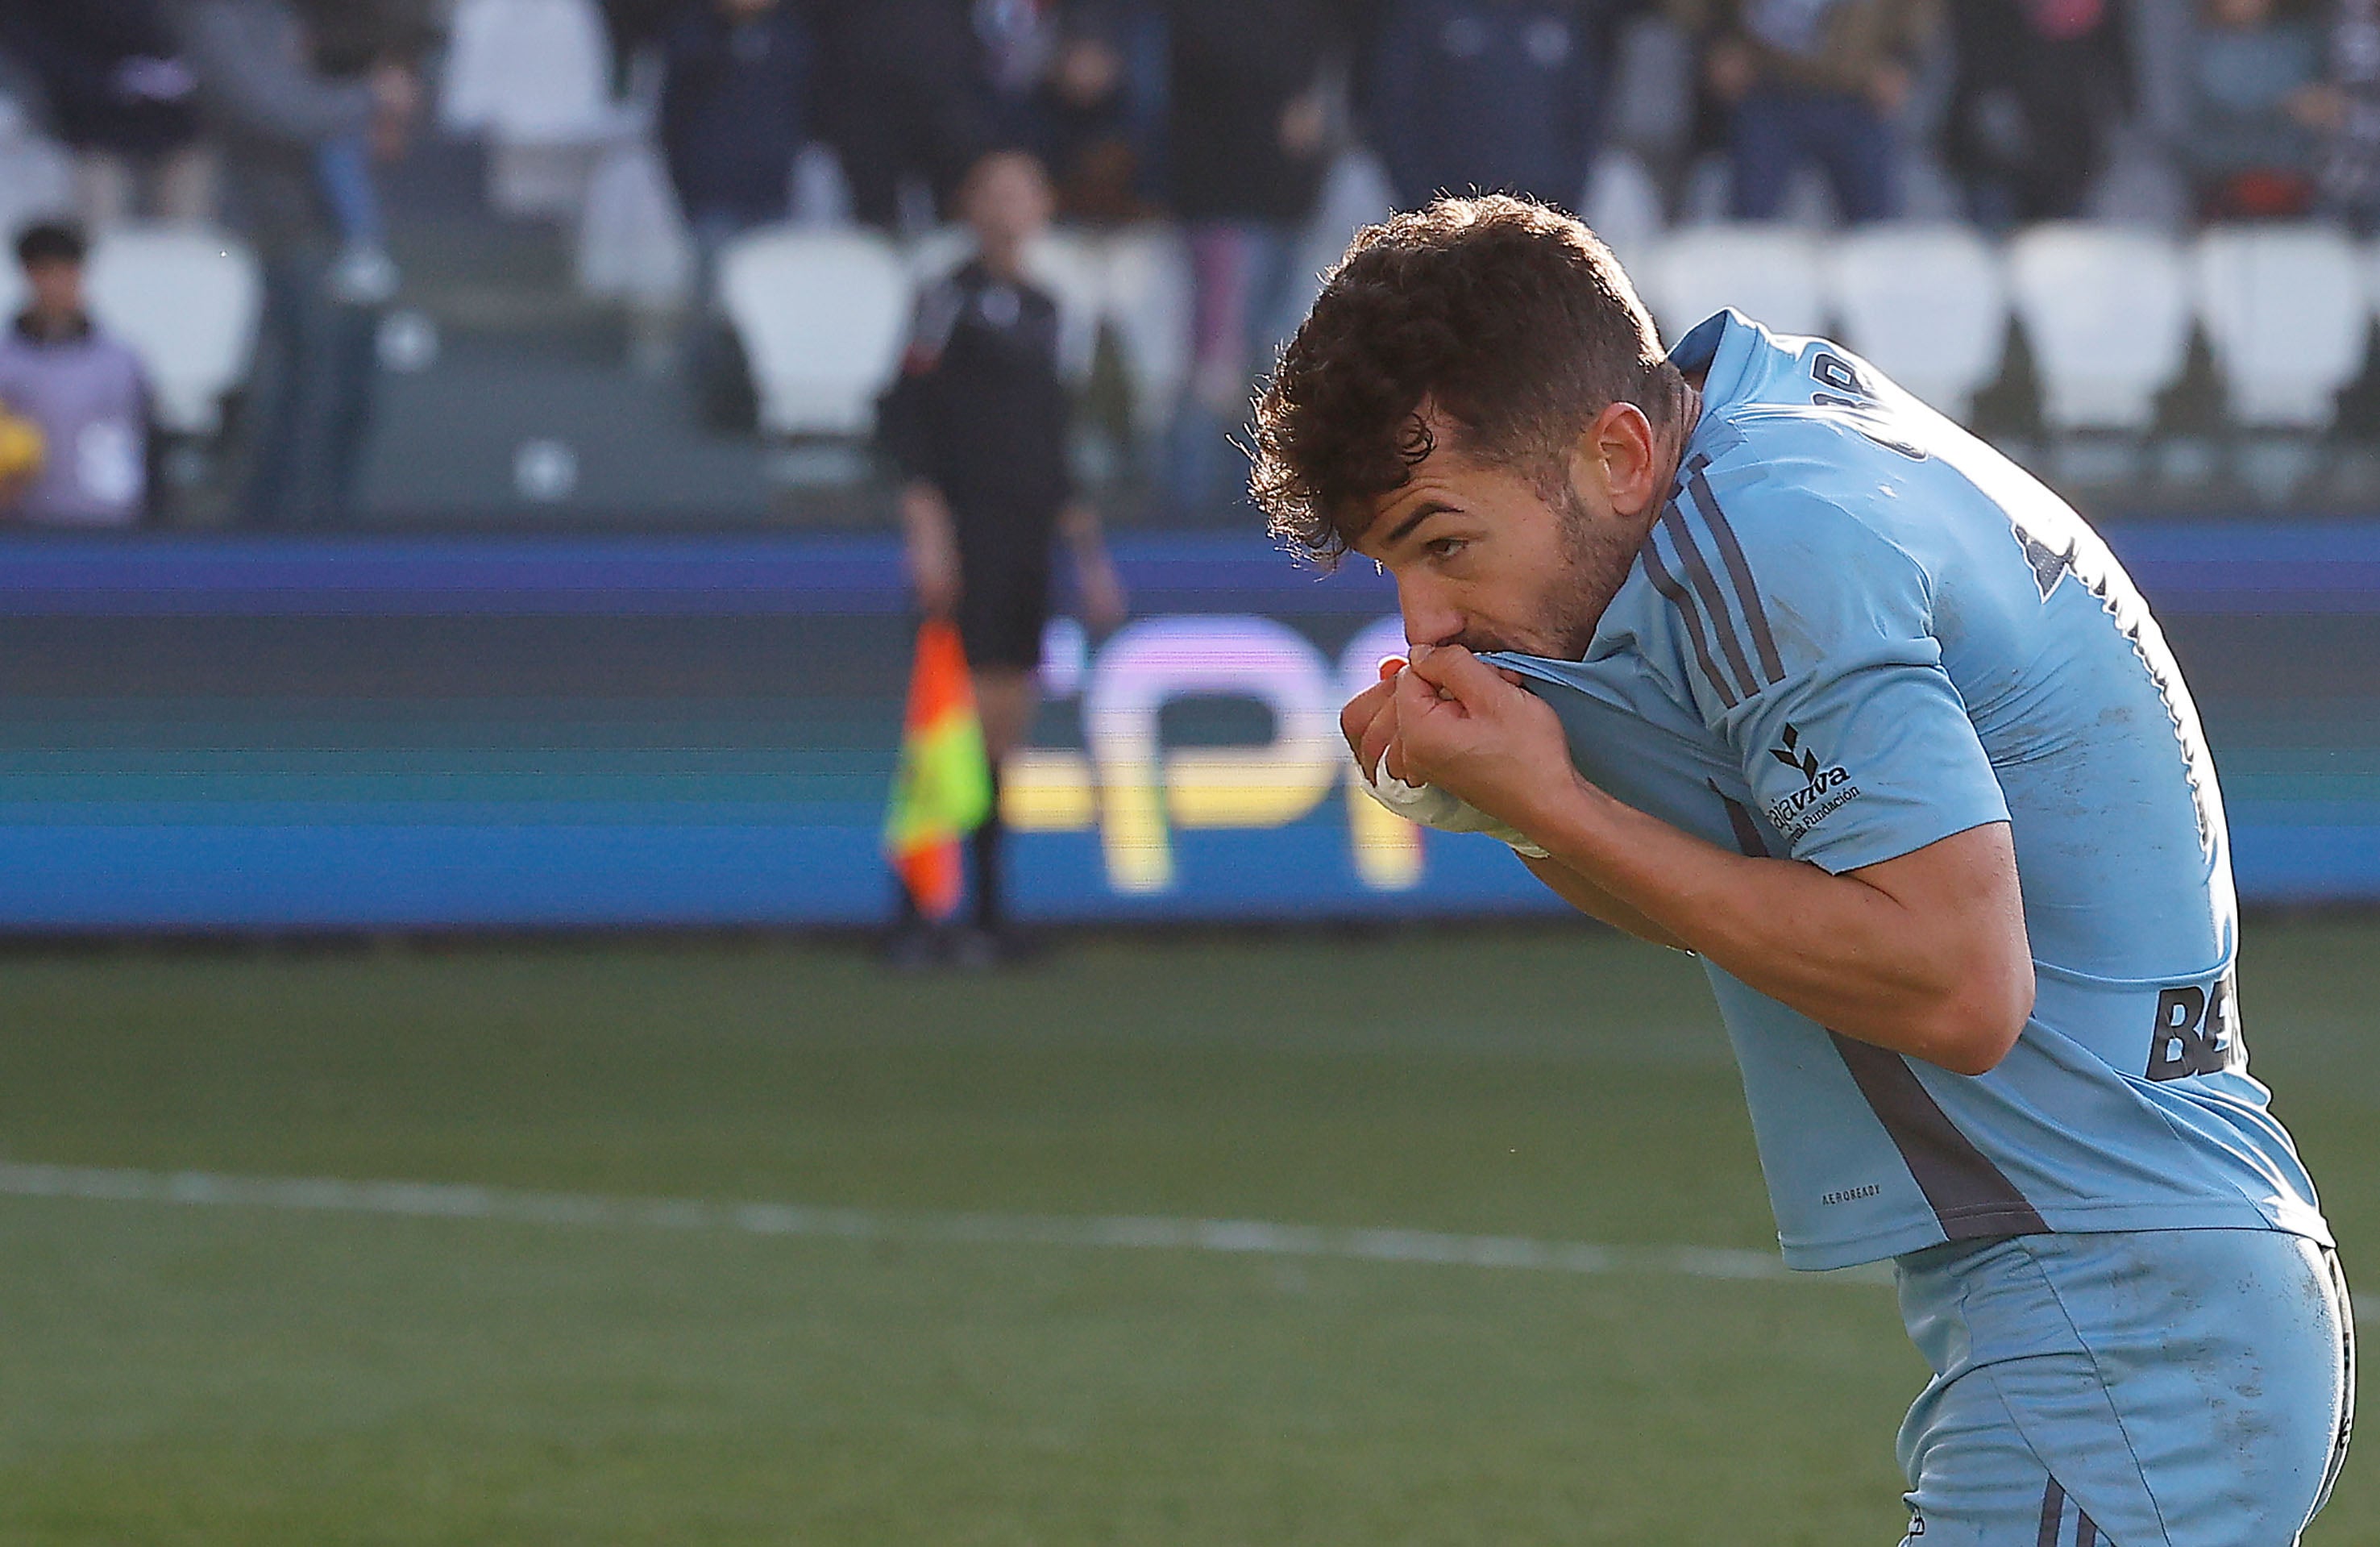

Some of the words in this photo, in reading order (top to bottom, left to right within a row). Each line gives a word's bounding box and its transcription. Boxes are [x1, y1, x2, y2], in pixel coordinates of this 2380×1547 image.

[1767, 764, 1851, 832] ajaviva
[1802, 786, 1860, 830] Fundación
[2144, 979, 2233, 1082] BE
[1821, 1183, 1879, 1205] AEROREADY
